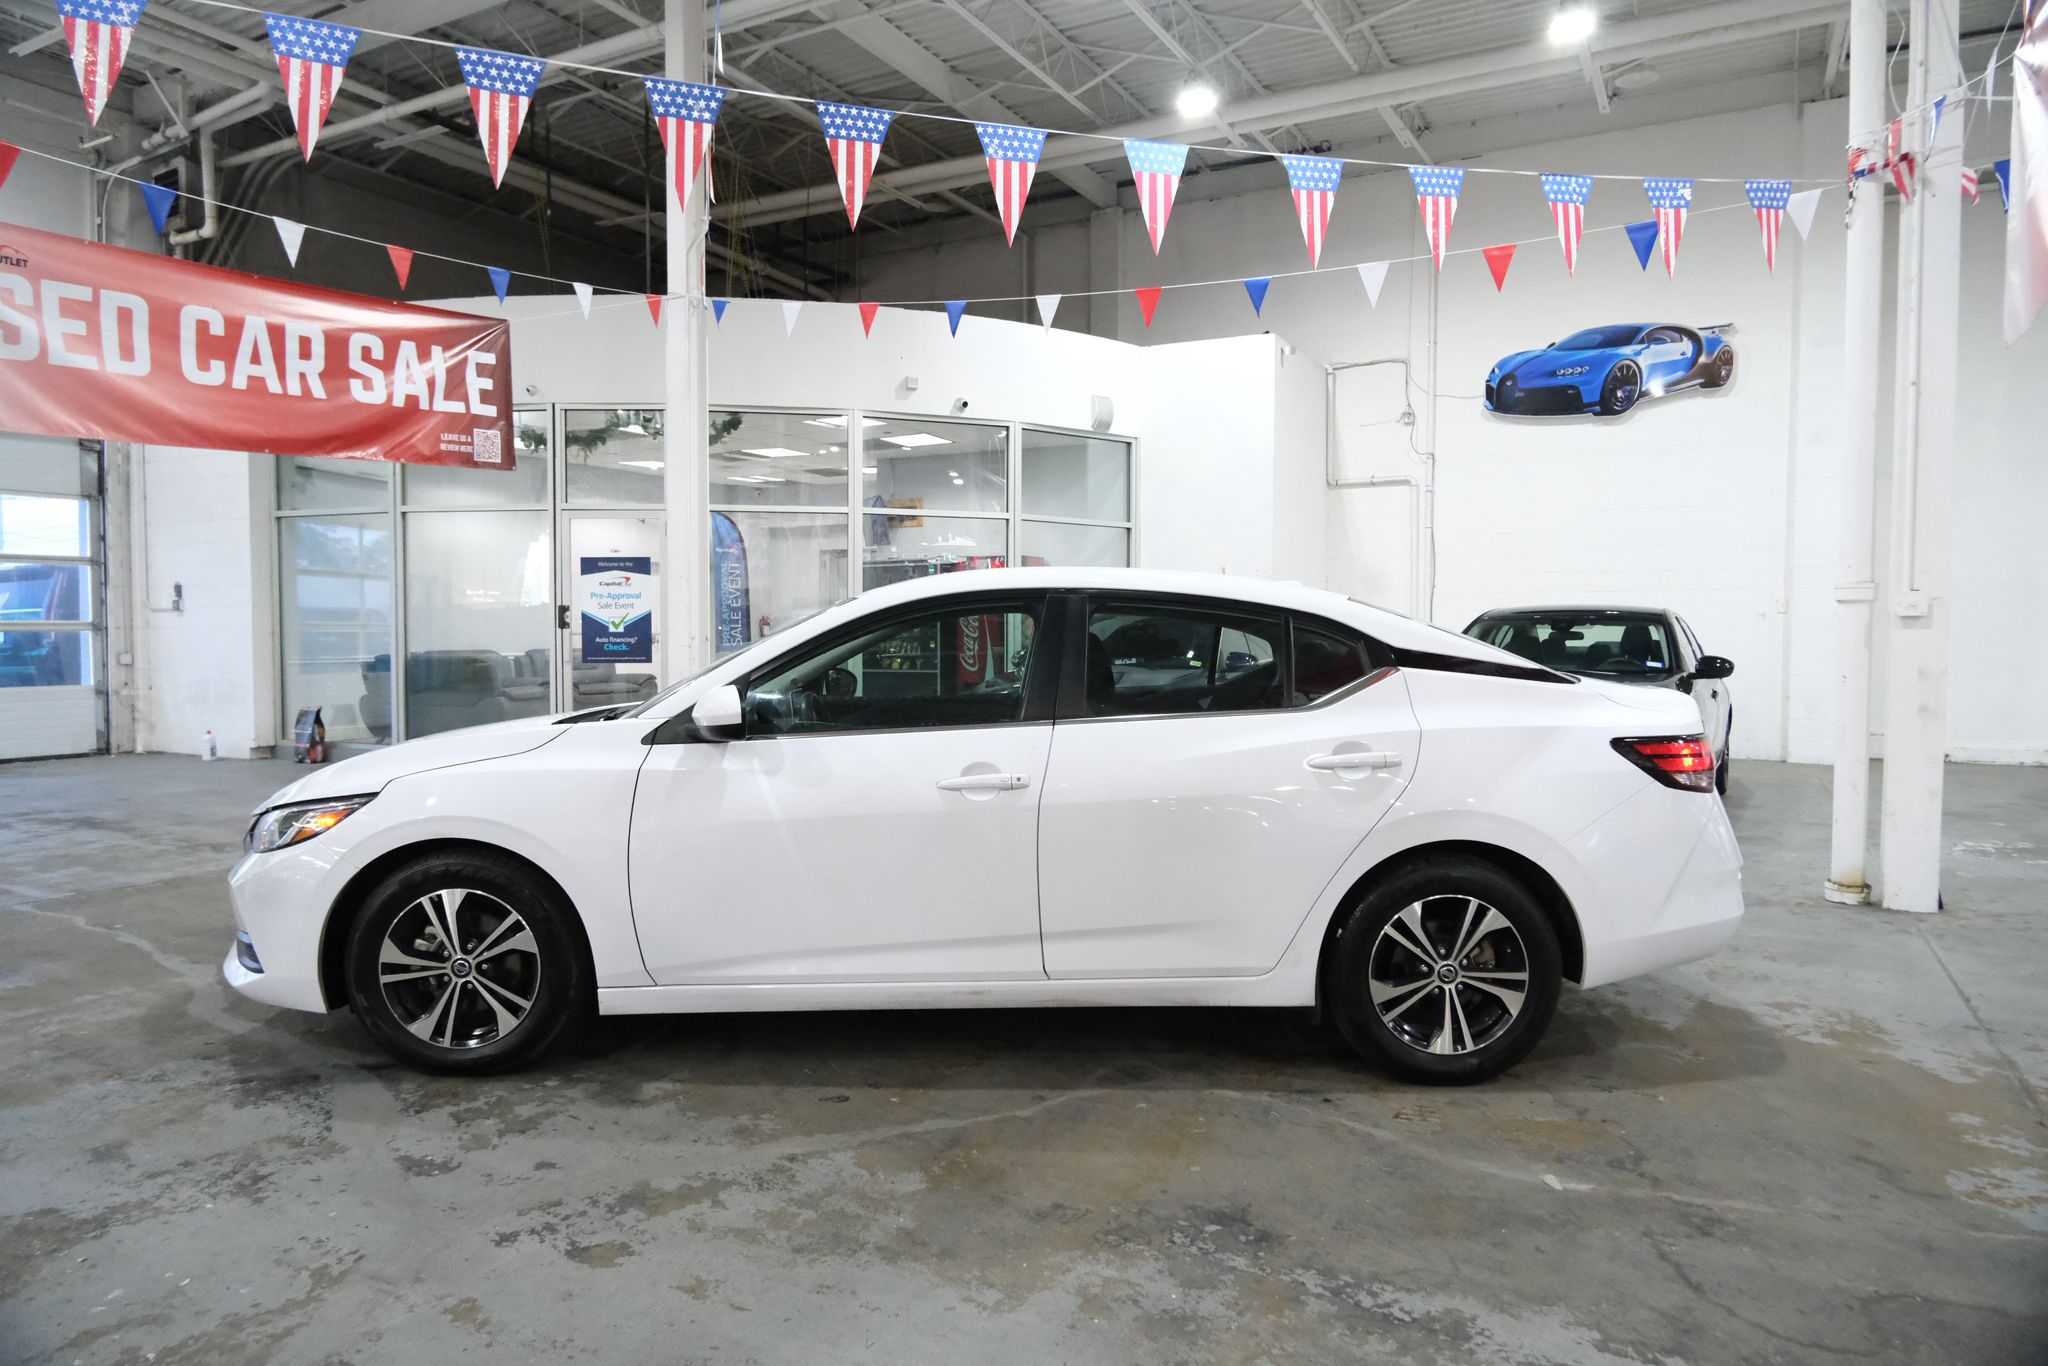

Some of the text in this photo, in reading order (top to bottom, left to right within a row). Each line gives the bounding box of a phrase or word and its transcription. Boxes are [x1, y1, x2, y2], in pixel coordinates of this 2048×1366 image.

[180, 304, 328, 400] CAR
[349, 332, 498, 417] SALE
[440, 432, 459, 441] LEAVE
[590, 592, 642, 600] Pre-Approval
[721, 560, 731, 646] PRE-APPROVAL
[728, 560, 742, 646] SALE EVENT
[609, 636, 638, 644] financing?
[604, 643, 629, 651] Check.
